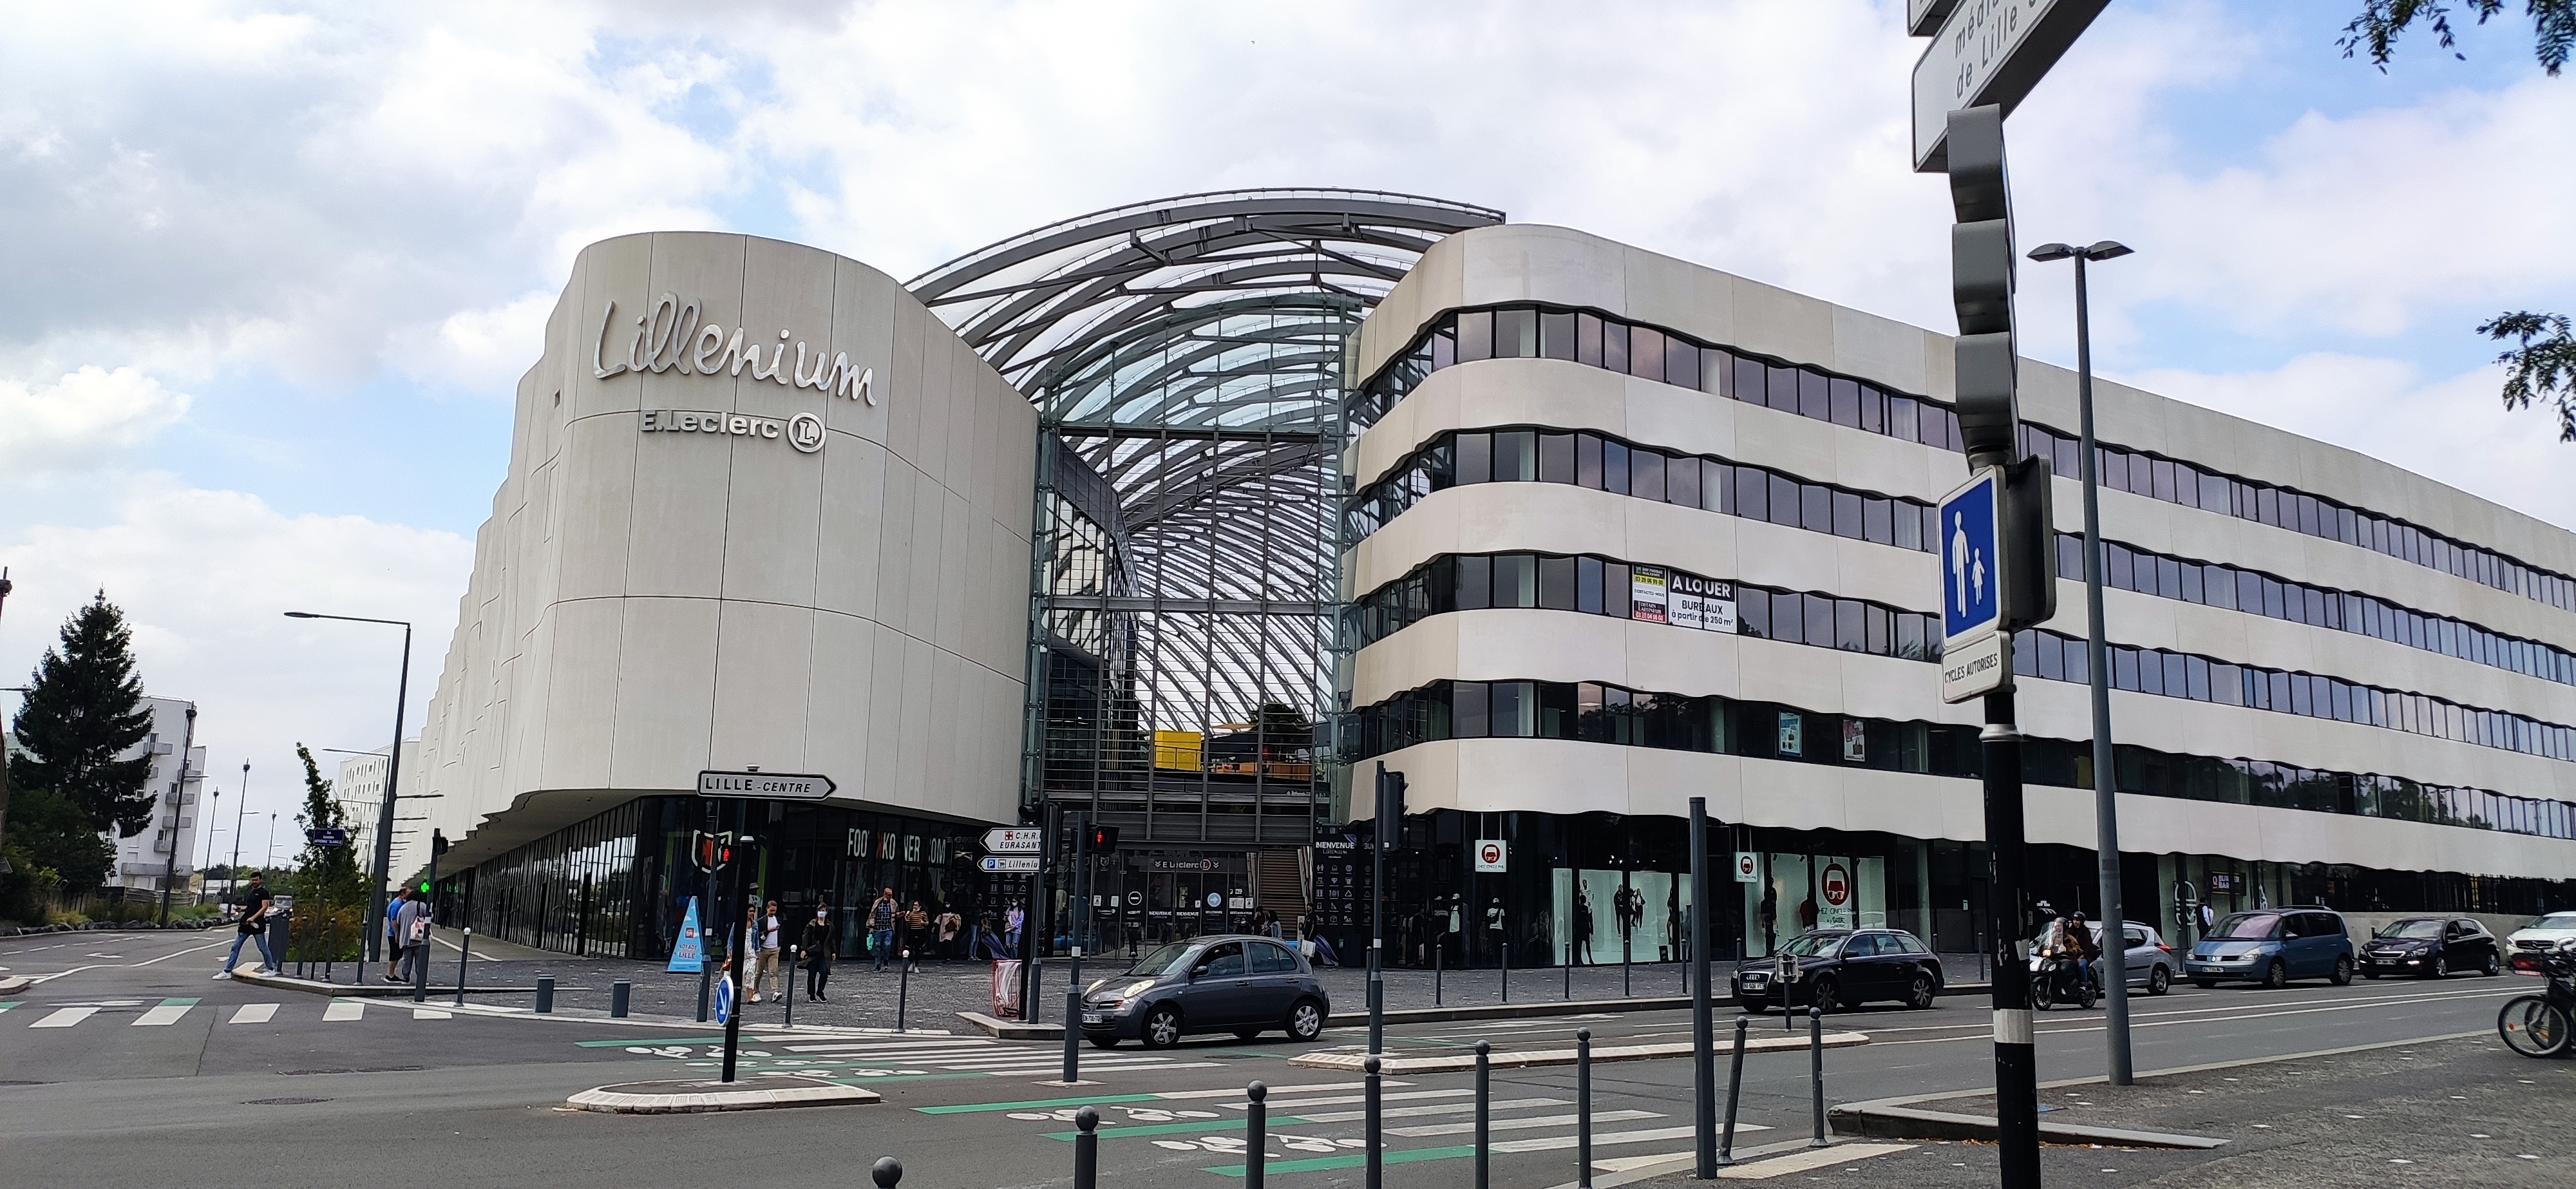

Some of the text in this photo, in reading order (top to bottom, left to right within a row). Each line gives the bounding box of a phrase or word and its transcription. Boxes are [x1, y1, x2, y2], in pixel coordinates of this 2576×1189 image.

[1956, 5, 2018, 99] de Lille
[592, 291, 877, 406] Lillenium
[640, 409, 779, 439] E.Leclerc
[1672, 576, 1730, 598] A LOUER
[1672, 609, 1676, 618] à
[1678, 612, 1698, 621] partir
[1682, 600, 1723, 615] BUREAUX
[1944, 652, 1998, 683] CYCLES AUTORISES
[848, 828, 869, 857] FOO
